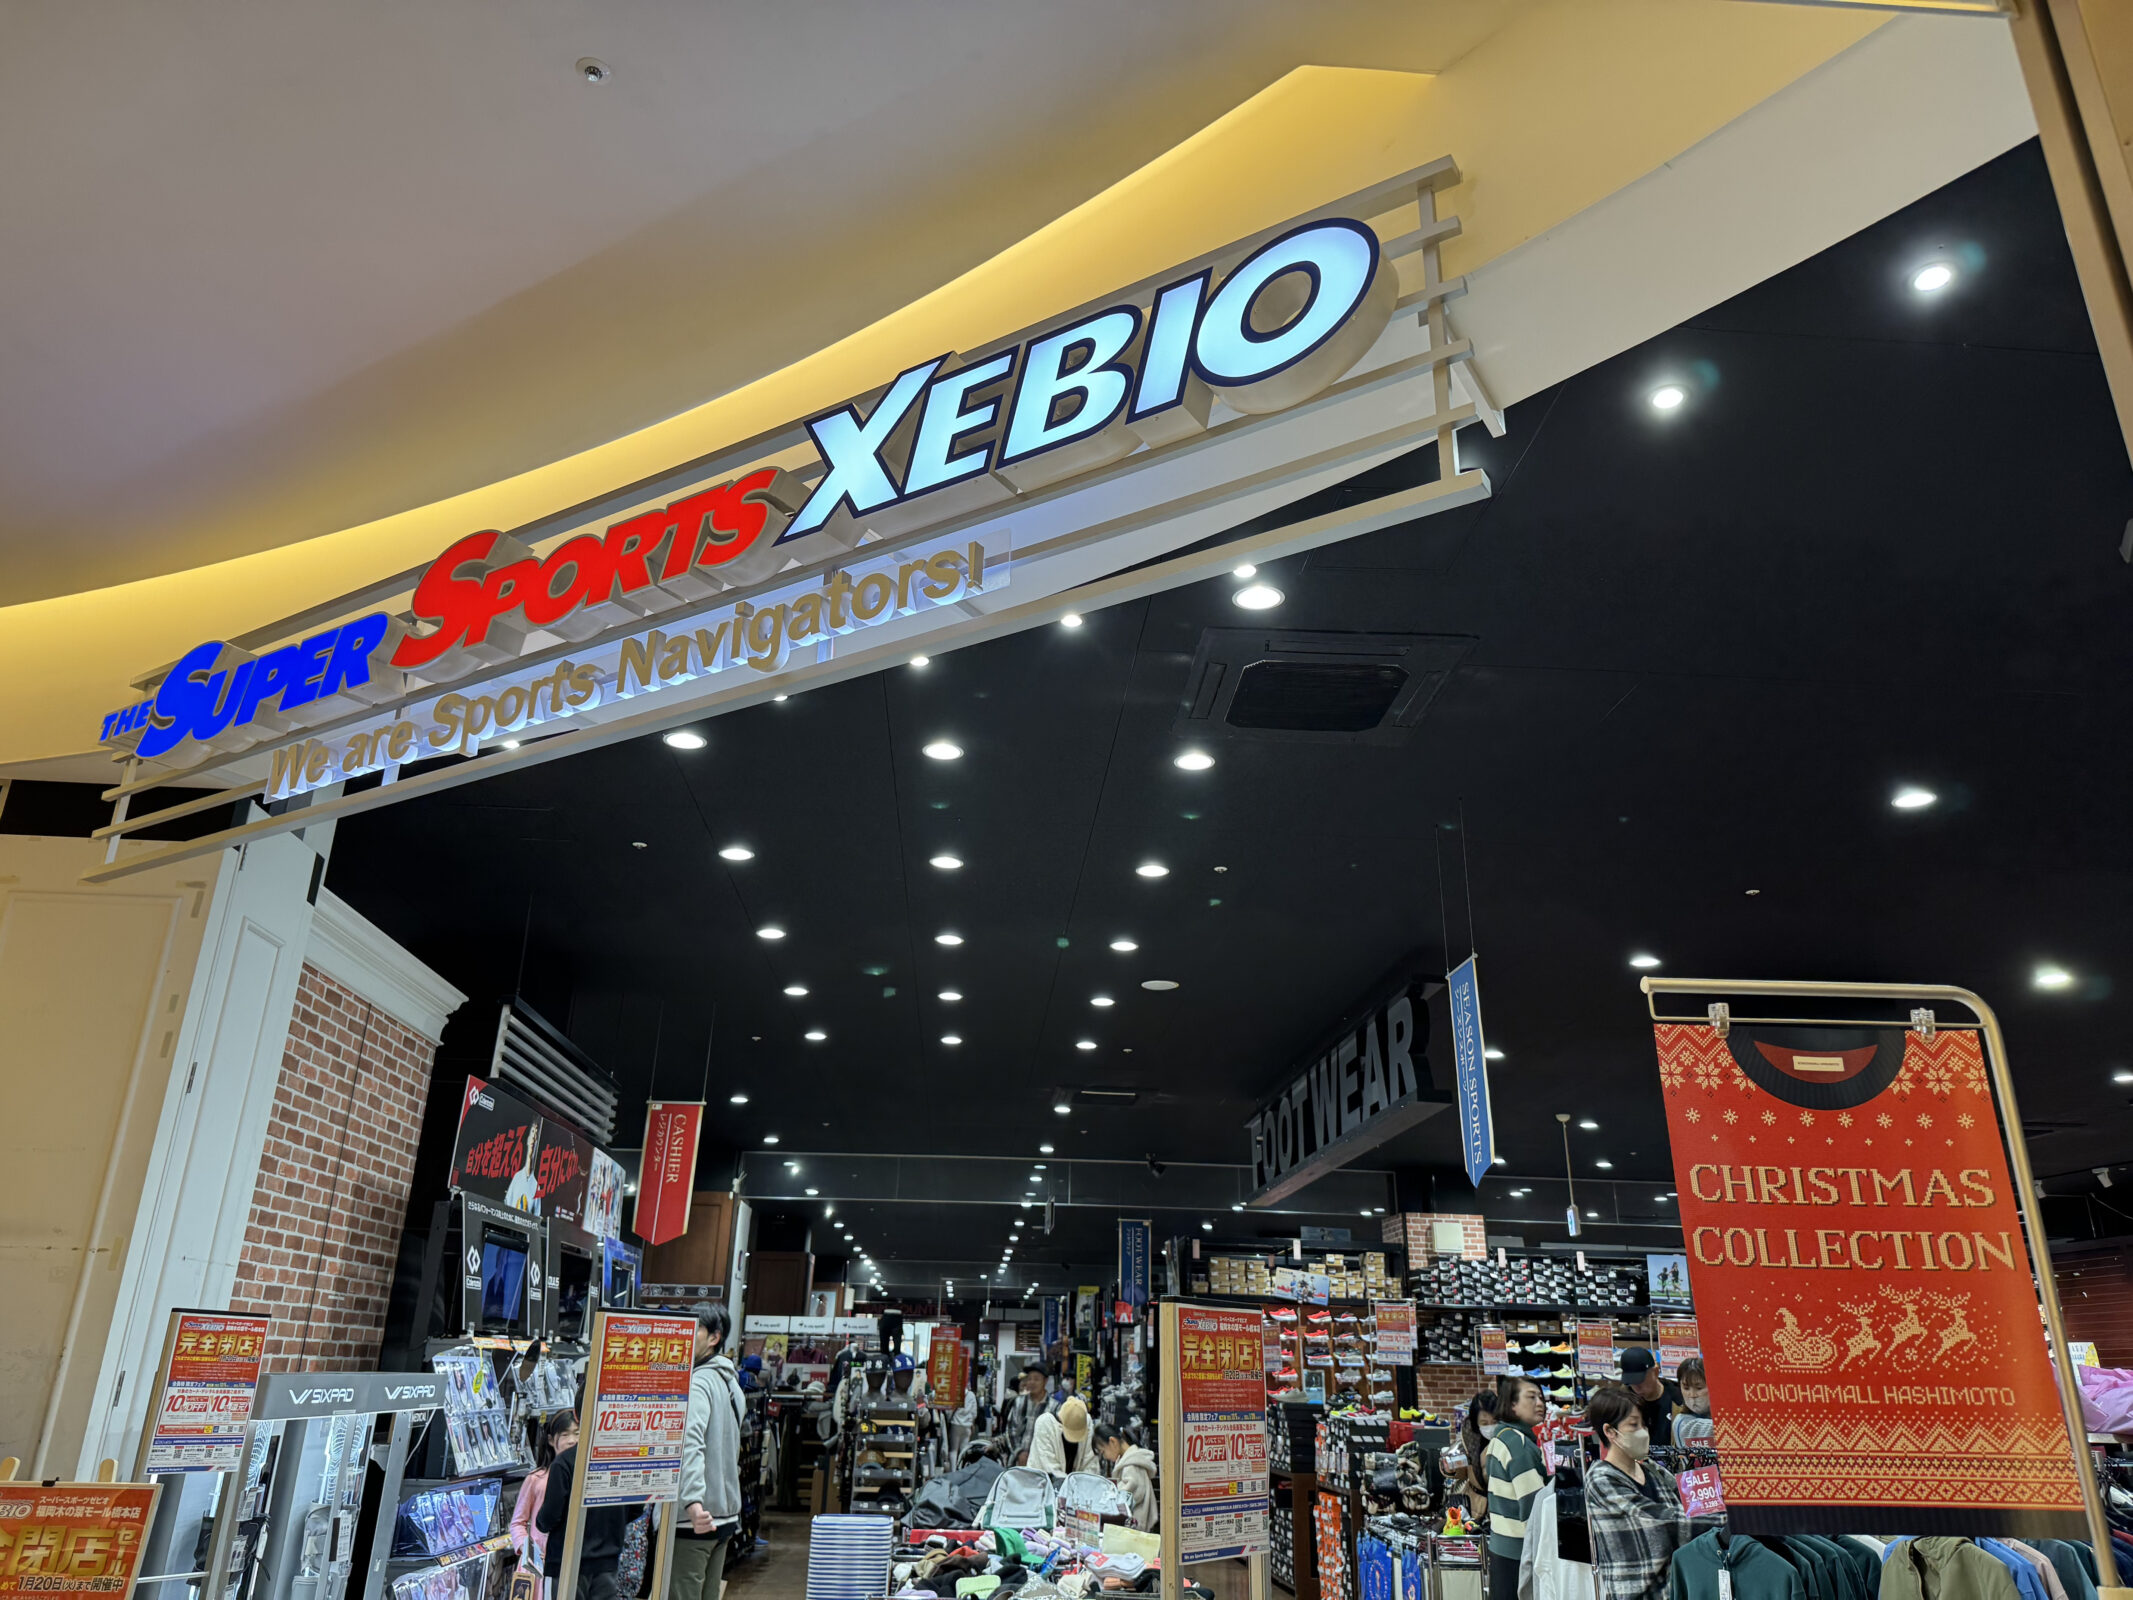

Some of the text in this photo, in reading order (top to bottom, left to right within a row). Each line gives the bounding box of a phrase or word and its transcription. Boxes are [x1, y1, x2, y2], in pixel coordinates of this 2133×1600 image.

[99, 216, 1381, 759] THE SUPER SPORTS XEBIO
[269, 540, 986, 797] We are Sports Navigators!
[1461, 981, 1483, 1164] SEASON SPORTS
[465, 1125, 528, 1180] 自分を超える
[653, 1113, 668, 1172] レジカウンター
[666, 1113, 687, 1184] CASHIER
[1689, 1164, 1997, 1208] CHRISTMAS
[1692, 1226, 2017, 1271] COLLECTION
[1135, 1256, 1143, 1286] WEAR
[176, 1332, 254, 1356] 完全閉店
[605, 1335, 683, 1363] 完全閉店
[1182, 1335, 1254, 1370] 完全閉店
[311, 1388, 355, 1404] SIXPAD
[401, 1385, 436, 1400] SIXPAD
[1744, 1383, 2016, 1407] KONOHAMALL HASHIMOTO
[1691, 1440, 1709, 1448] SALE
[1685, 1472, 1711, 1487] SALE
[36, 1505, 142, 1519] 福岡木の葉モール橋本店
[40, 1496, 110, 1505] スーパースポーツゼビオ
[106, 1526, 137, 1577] セール
